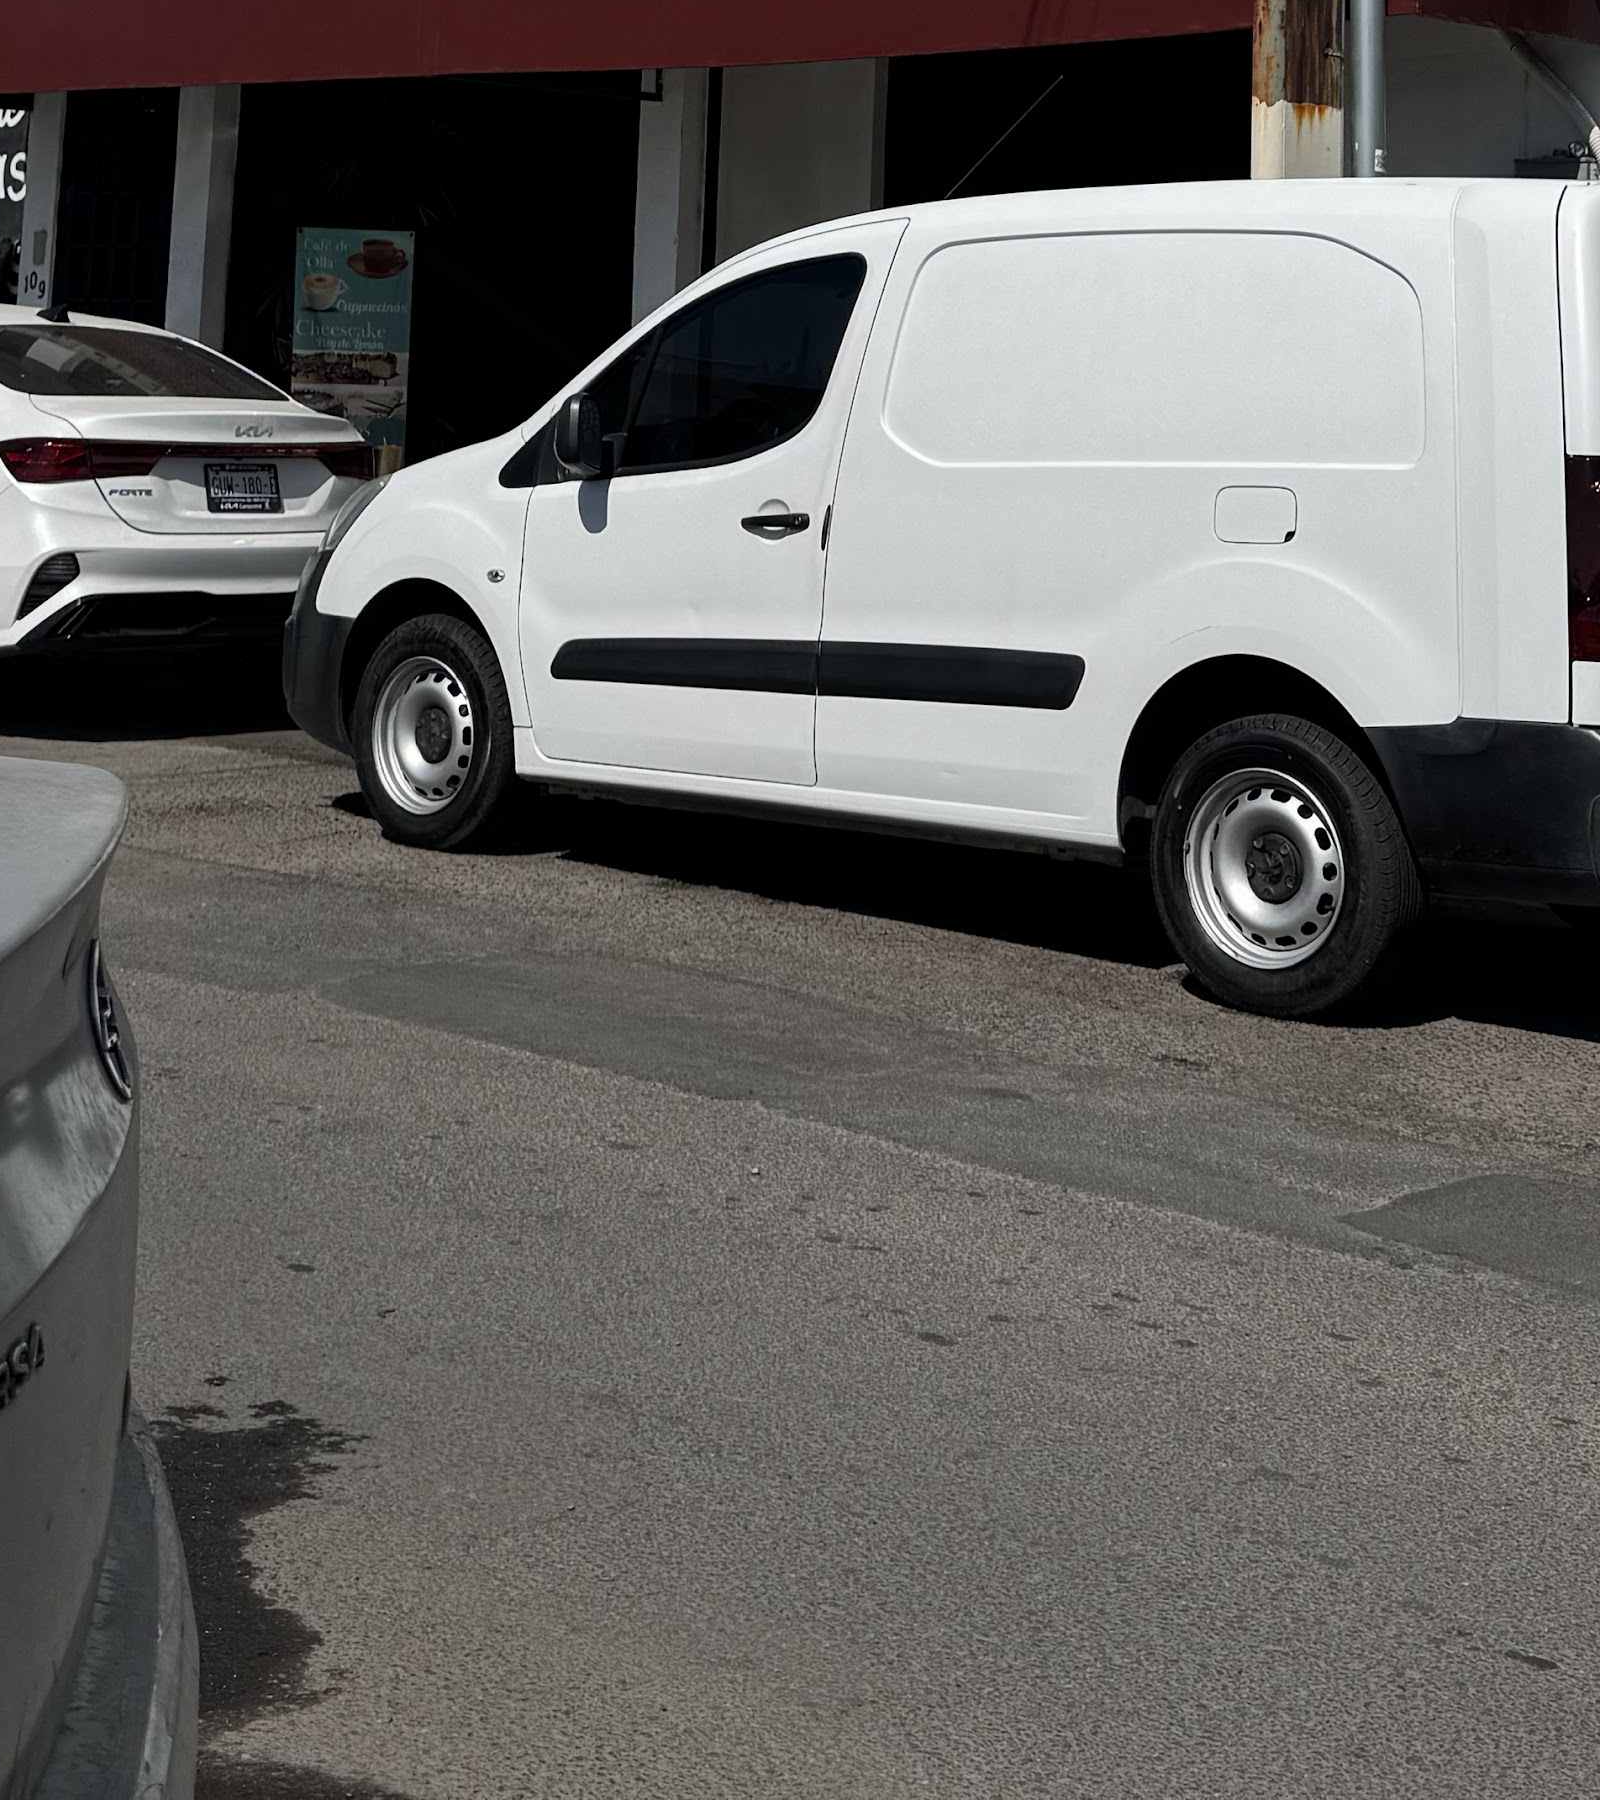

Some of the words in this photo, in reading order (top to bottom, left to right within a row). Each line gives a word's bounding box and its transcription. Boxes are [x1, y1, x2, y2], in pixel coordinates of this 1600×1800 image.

[24, 271, 46, 299] 109
[235, 424, 274, 439] KIA
[108, 488, 153, 497] FORTE
